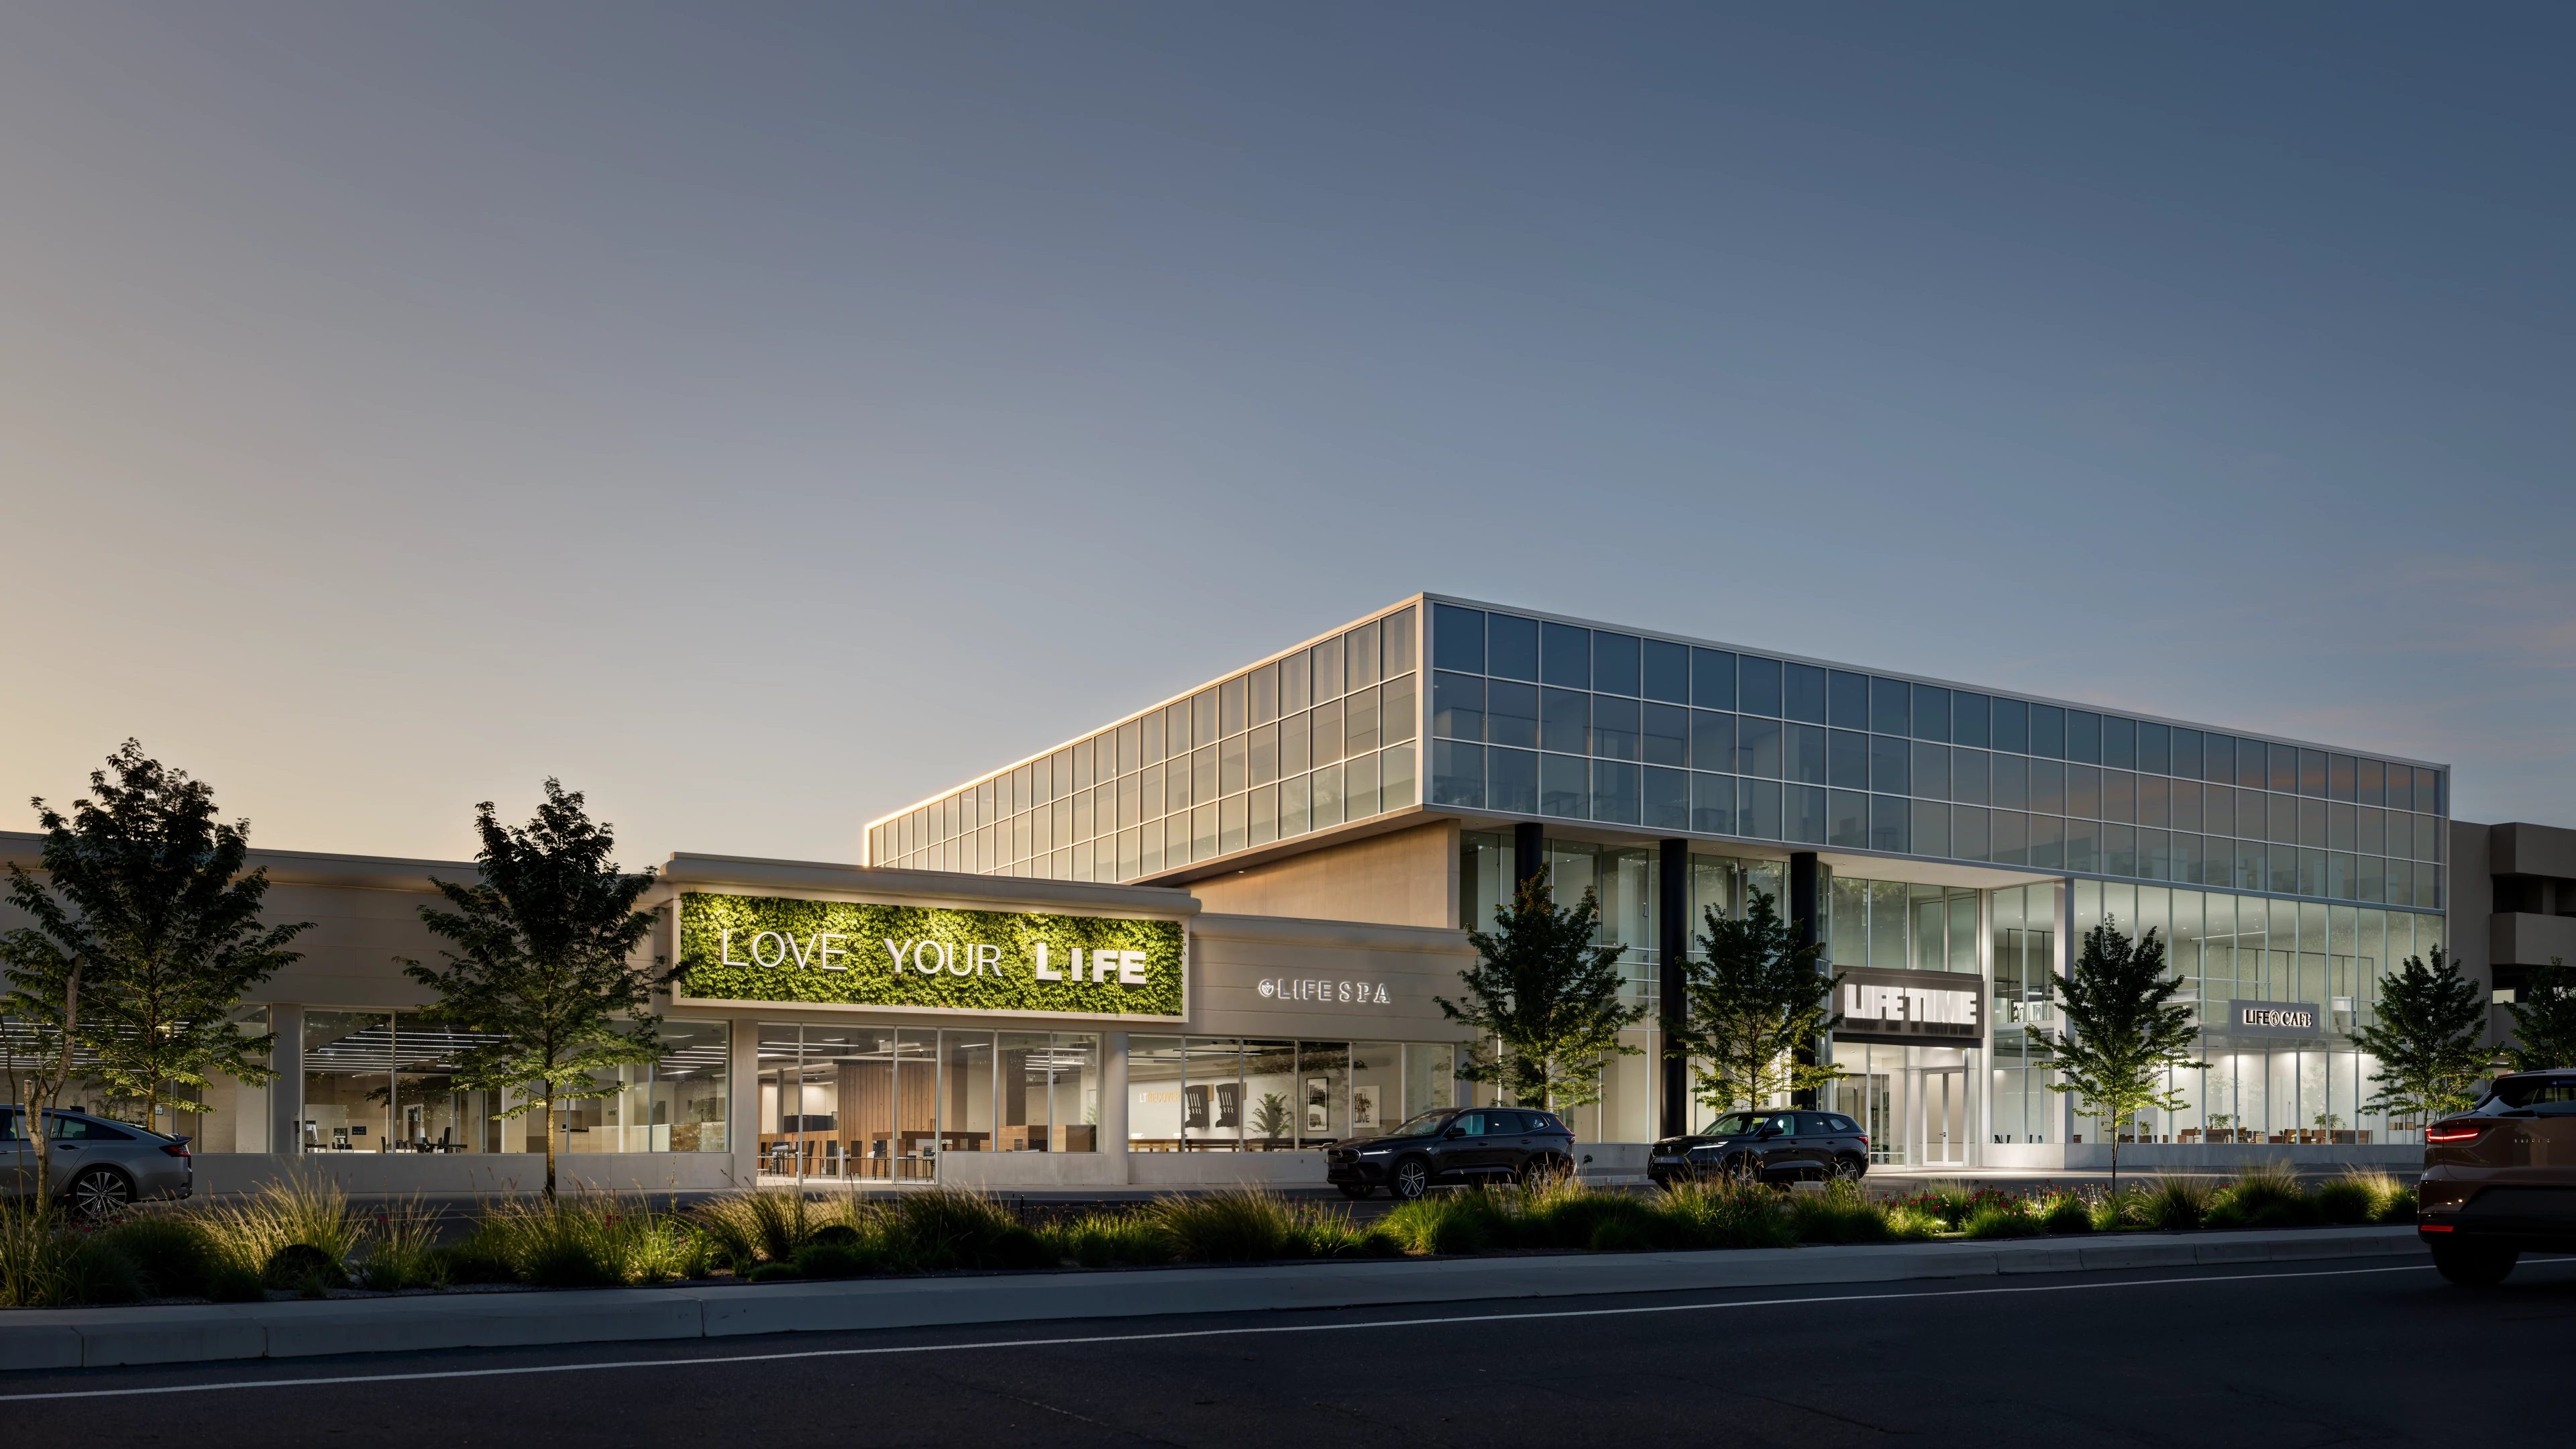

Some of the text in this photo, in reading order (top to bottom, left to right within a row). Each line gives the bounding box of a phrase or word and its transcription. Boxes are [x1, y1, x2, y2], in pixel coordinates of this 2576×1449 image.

[720, 928, 1147, 984] LOVE YOUR LIFE
[1277, 979, 1391, 1003] LIFE SPA
[2245, 1009, 2312, 1026] LIFE CAFE
